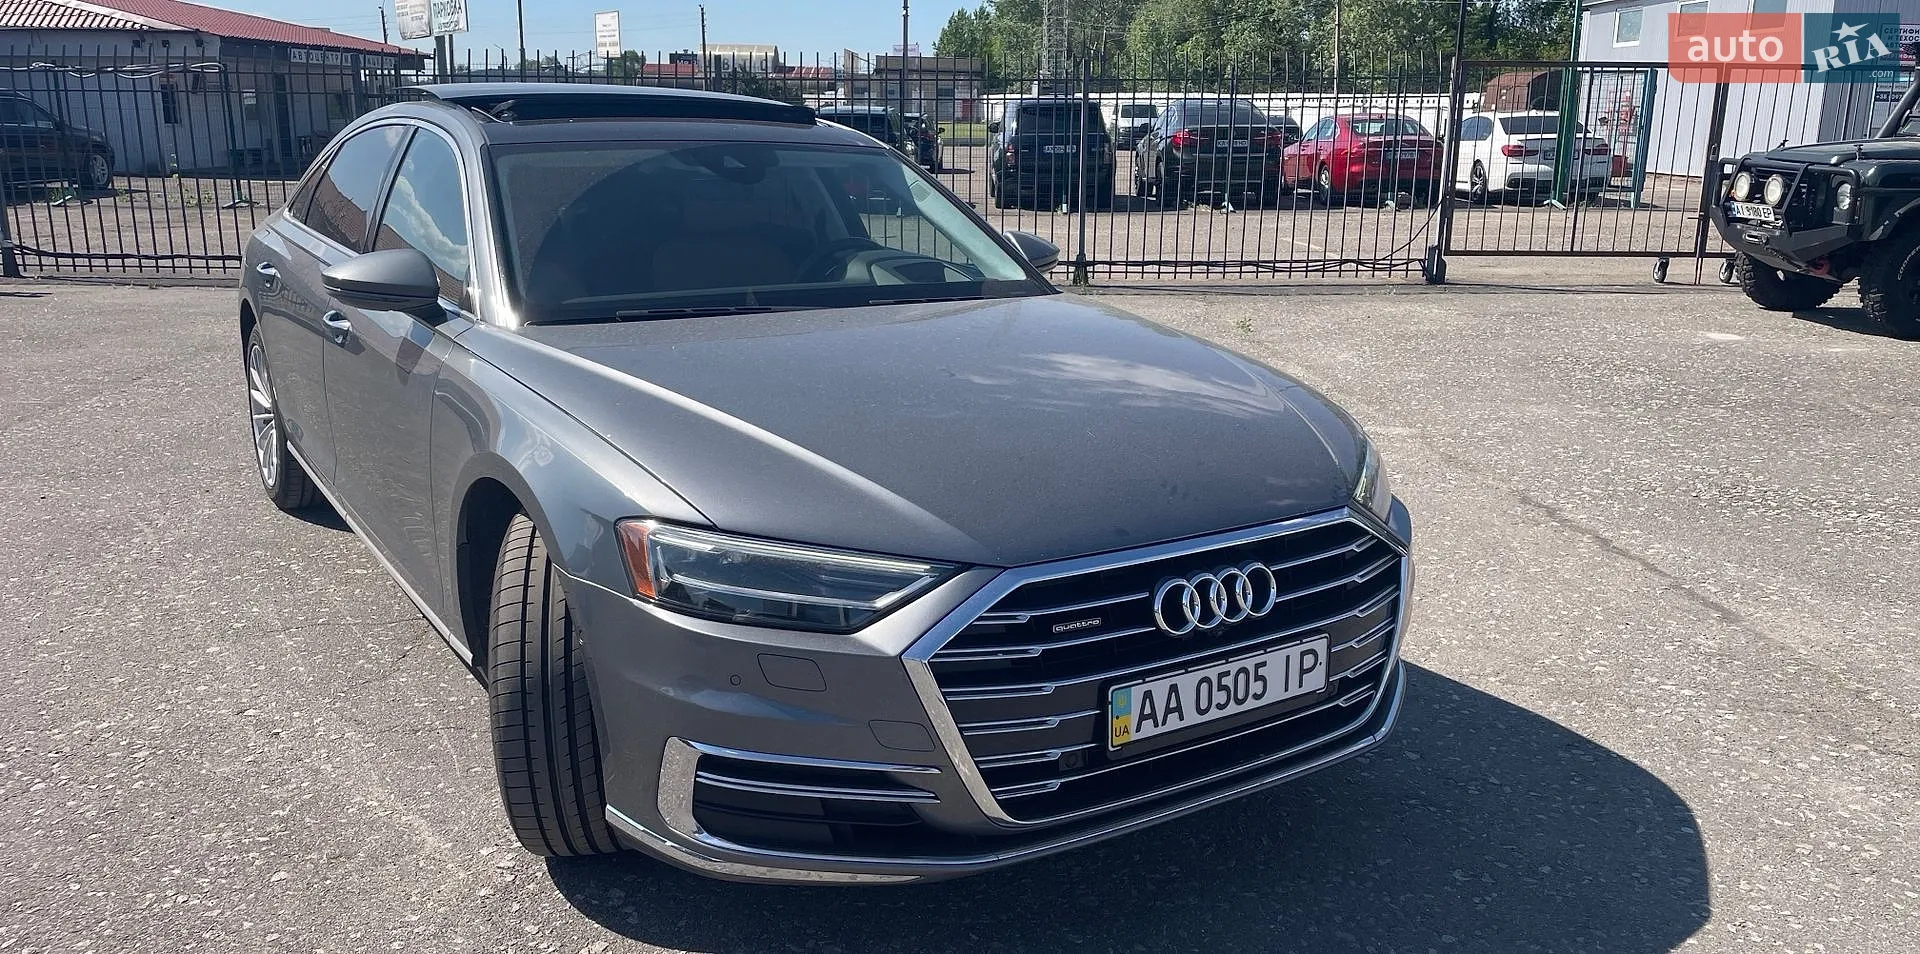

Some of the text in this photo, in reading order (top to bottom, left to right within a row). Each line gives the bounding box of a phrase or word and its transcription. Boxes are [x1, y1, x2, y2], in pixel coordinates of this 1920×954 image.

[1762, 207, 1772, 219] EP
[1055, 619, 1100, 632] quattro
[1135, 683, 1185, 733] AA
[1195, 661, 1267, 717] 0505
[1114, 725, 1130, 738] UA
